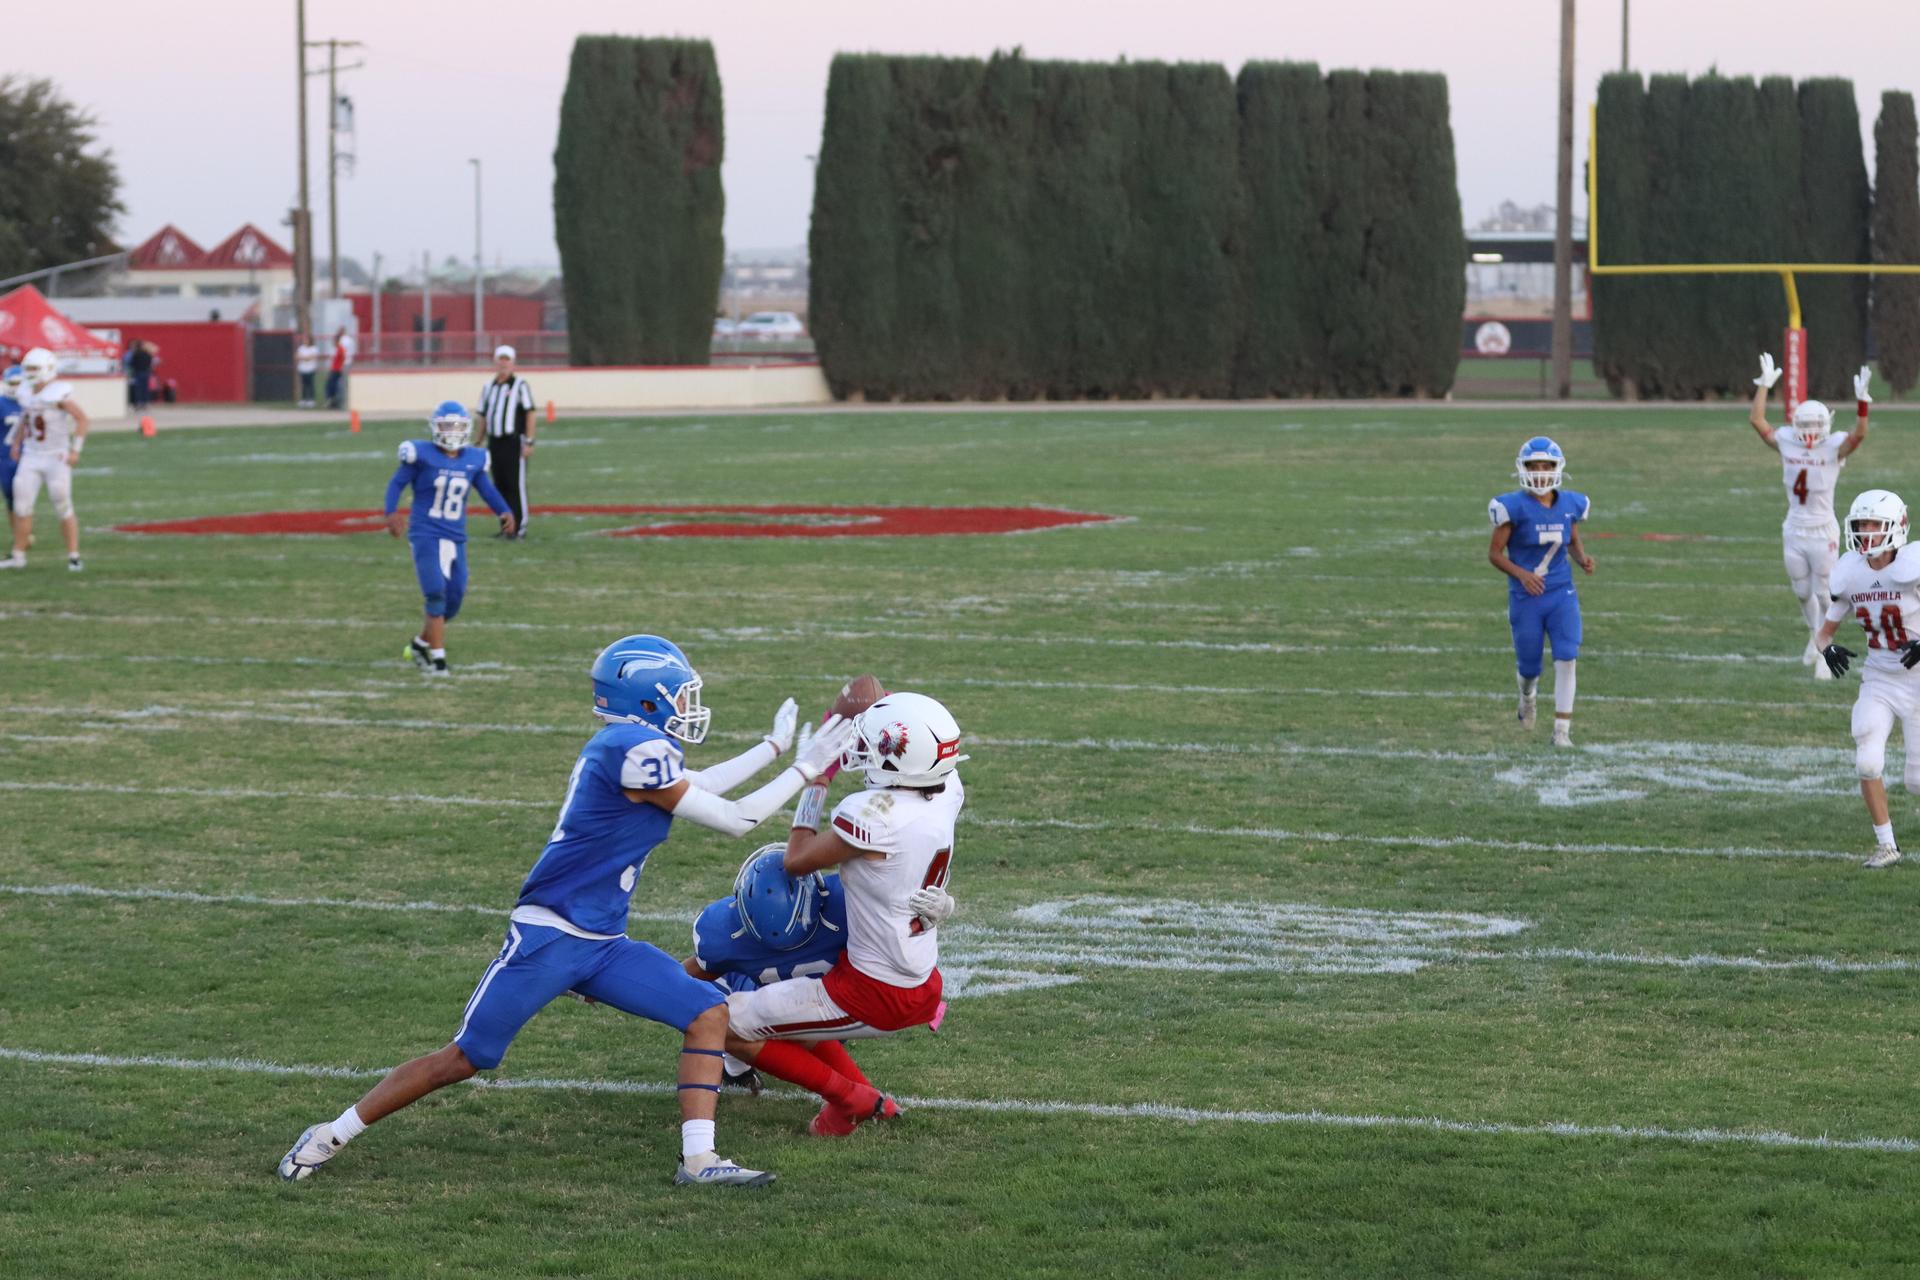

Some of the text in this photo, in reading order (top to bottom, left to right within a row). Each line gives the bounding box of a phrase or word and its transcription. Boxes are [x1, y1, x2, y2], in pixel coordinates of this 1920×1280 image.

[428, 475, 470, 521] 18
[1793, 468, 1809, 505] 4
[1533, 531, 1563, 577] 7
[1851, 591, 1902, 603] CHOWCHILLA
[641, 754, 675, 789] 31
